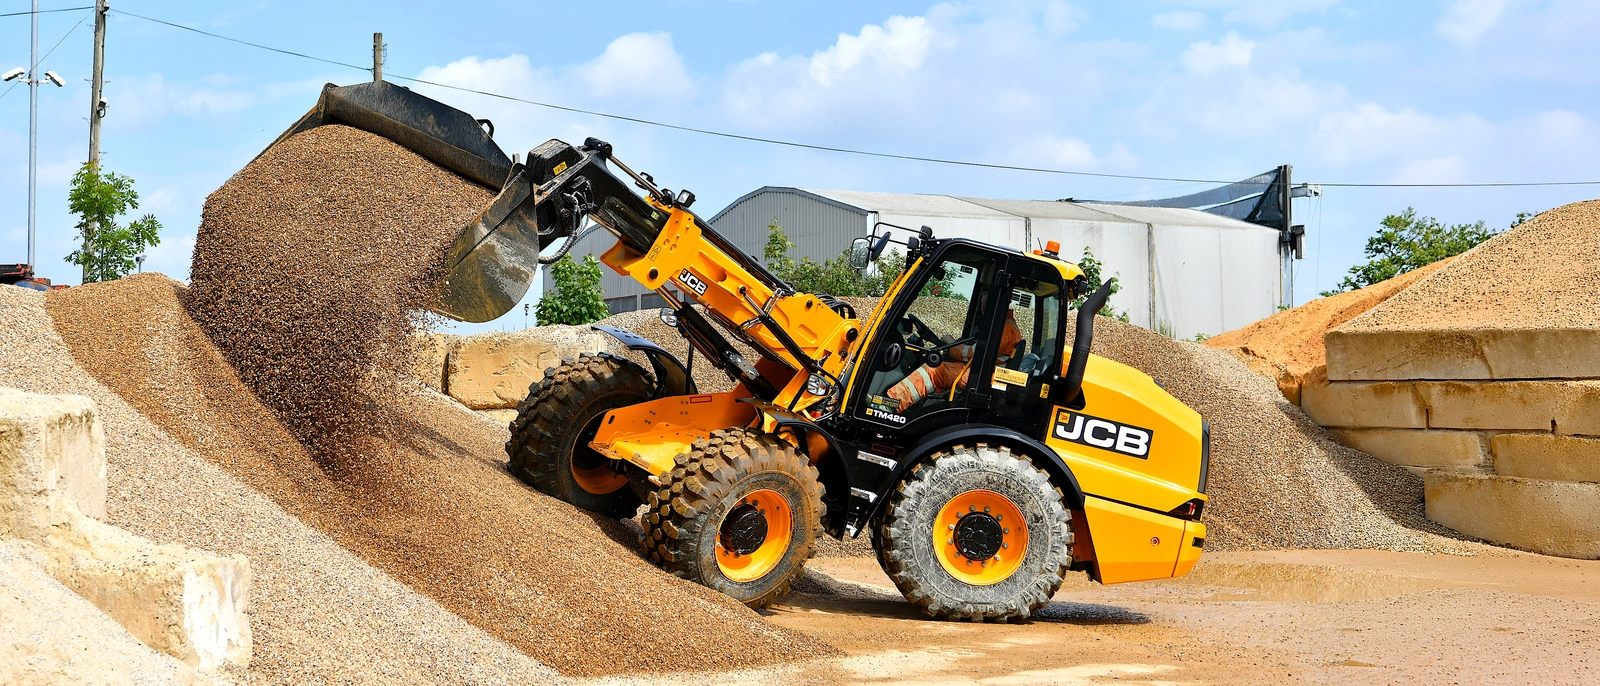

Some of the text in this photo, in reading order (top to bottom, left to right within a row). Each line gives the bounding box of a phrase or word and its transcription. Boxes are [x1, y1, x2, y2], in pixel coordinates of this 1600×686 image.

[680, 272, 707, 295] JCB
[873, 410, 907, 424] TM420
[1056, 415, 1149, 456] JCB
